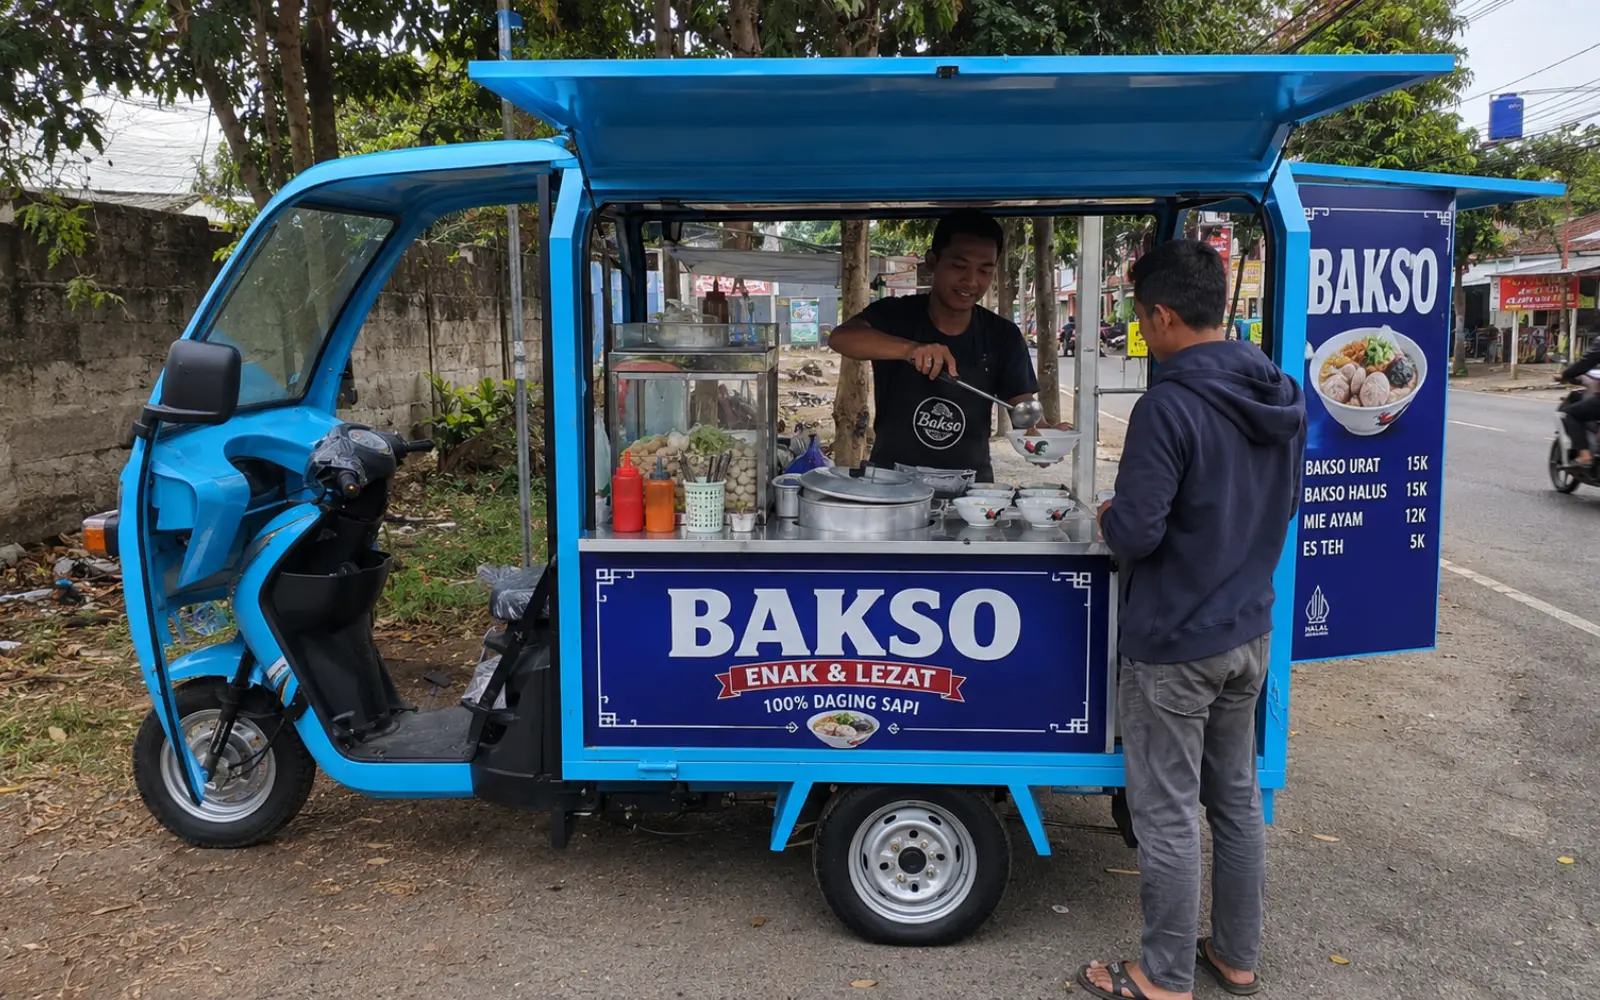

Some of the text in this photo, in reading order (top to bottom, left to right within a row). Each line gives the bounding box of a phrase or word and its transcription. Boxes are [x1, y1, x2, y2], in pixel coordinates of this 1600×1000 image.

[1307, 247, 1438, 315] BAKSO
[917, 411, 961, 432] Bakso
[1305, 455, 1429, 476] BAKSO URAT 15K
[1304, 481, 1428, 503] BAKSO HALUS 15K
[1303, 507, 1427, 530] MIE AYAM 12K
[1303, 533, 1426, 557] ES TEH 5K
[667, 587, 1021, 661] BAKSO
[1304, 624, 1329, 633] HALAL
[745, 663, 937, 690] ENAK & LEZAT
[763, 693, 920, 716] 100% DAGING SAPI
